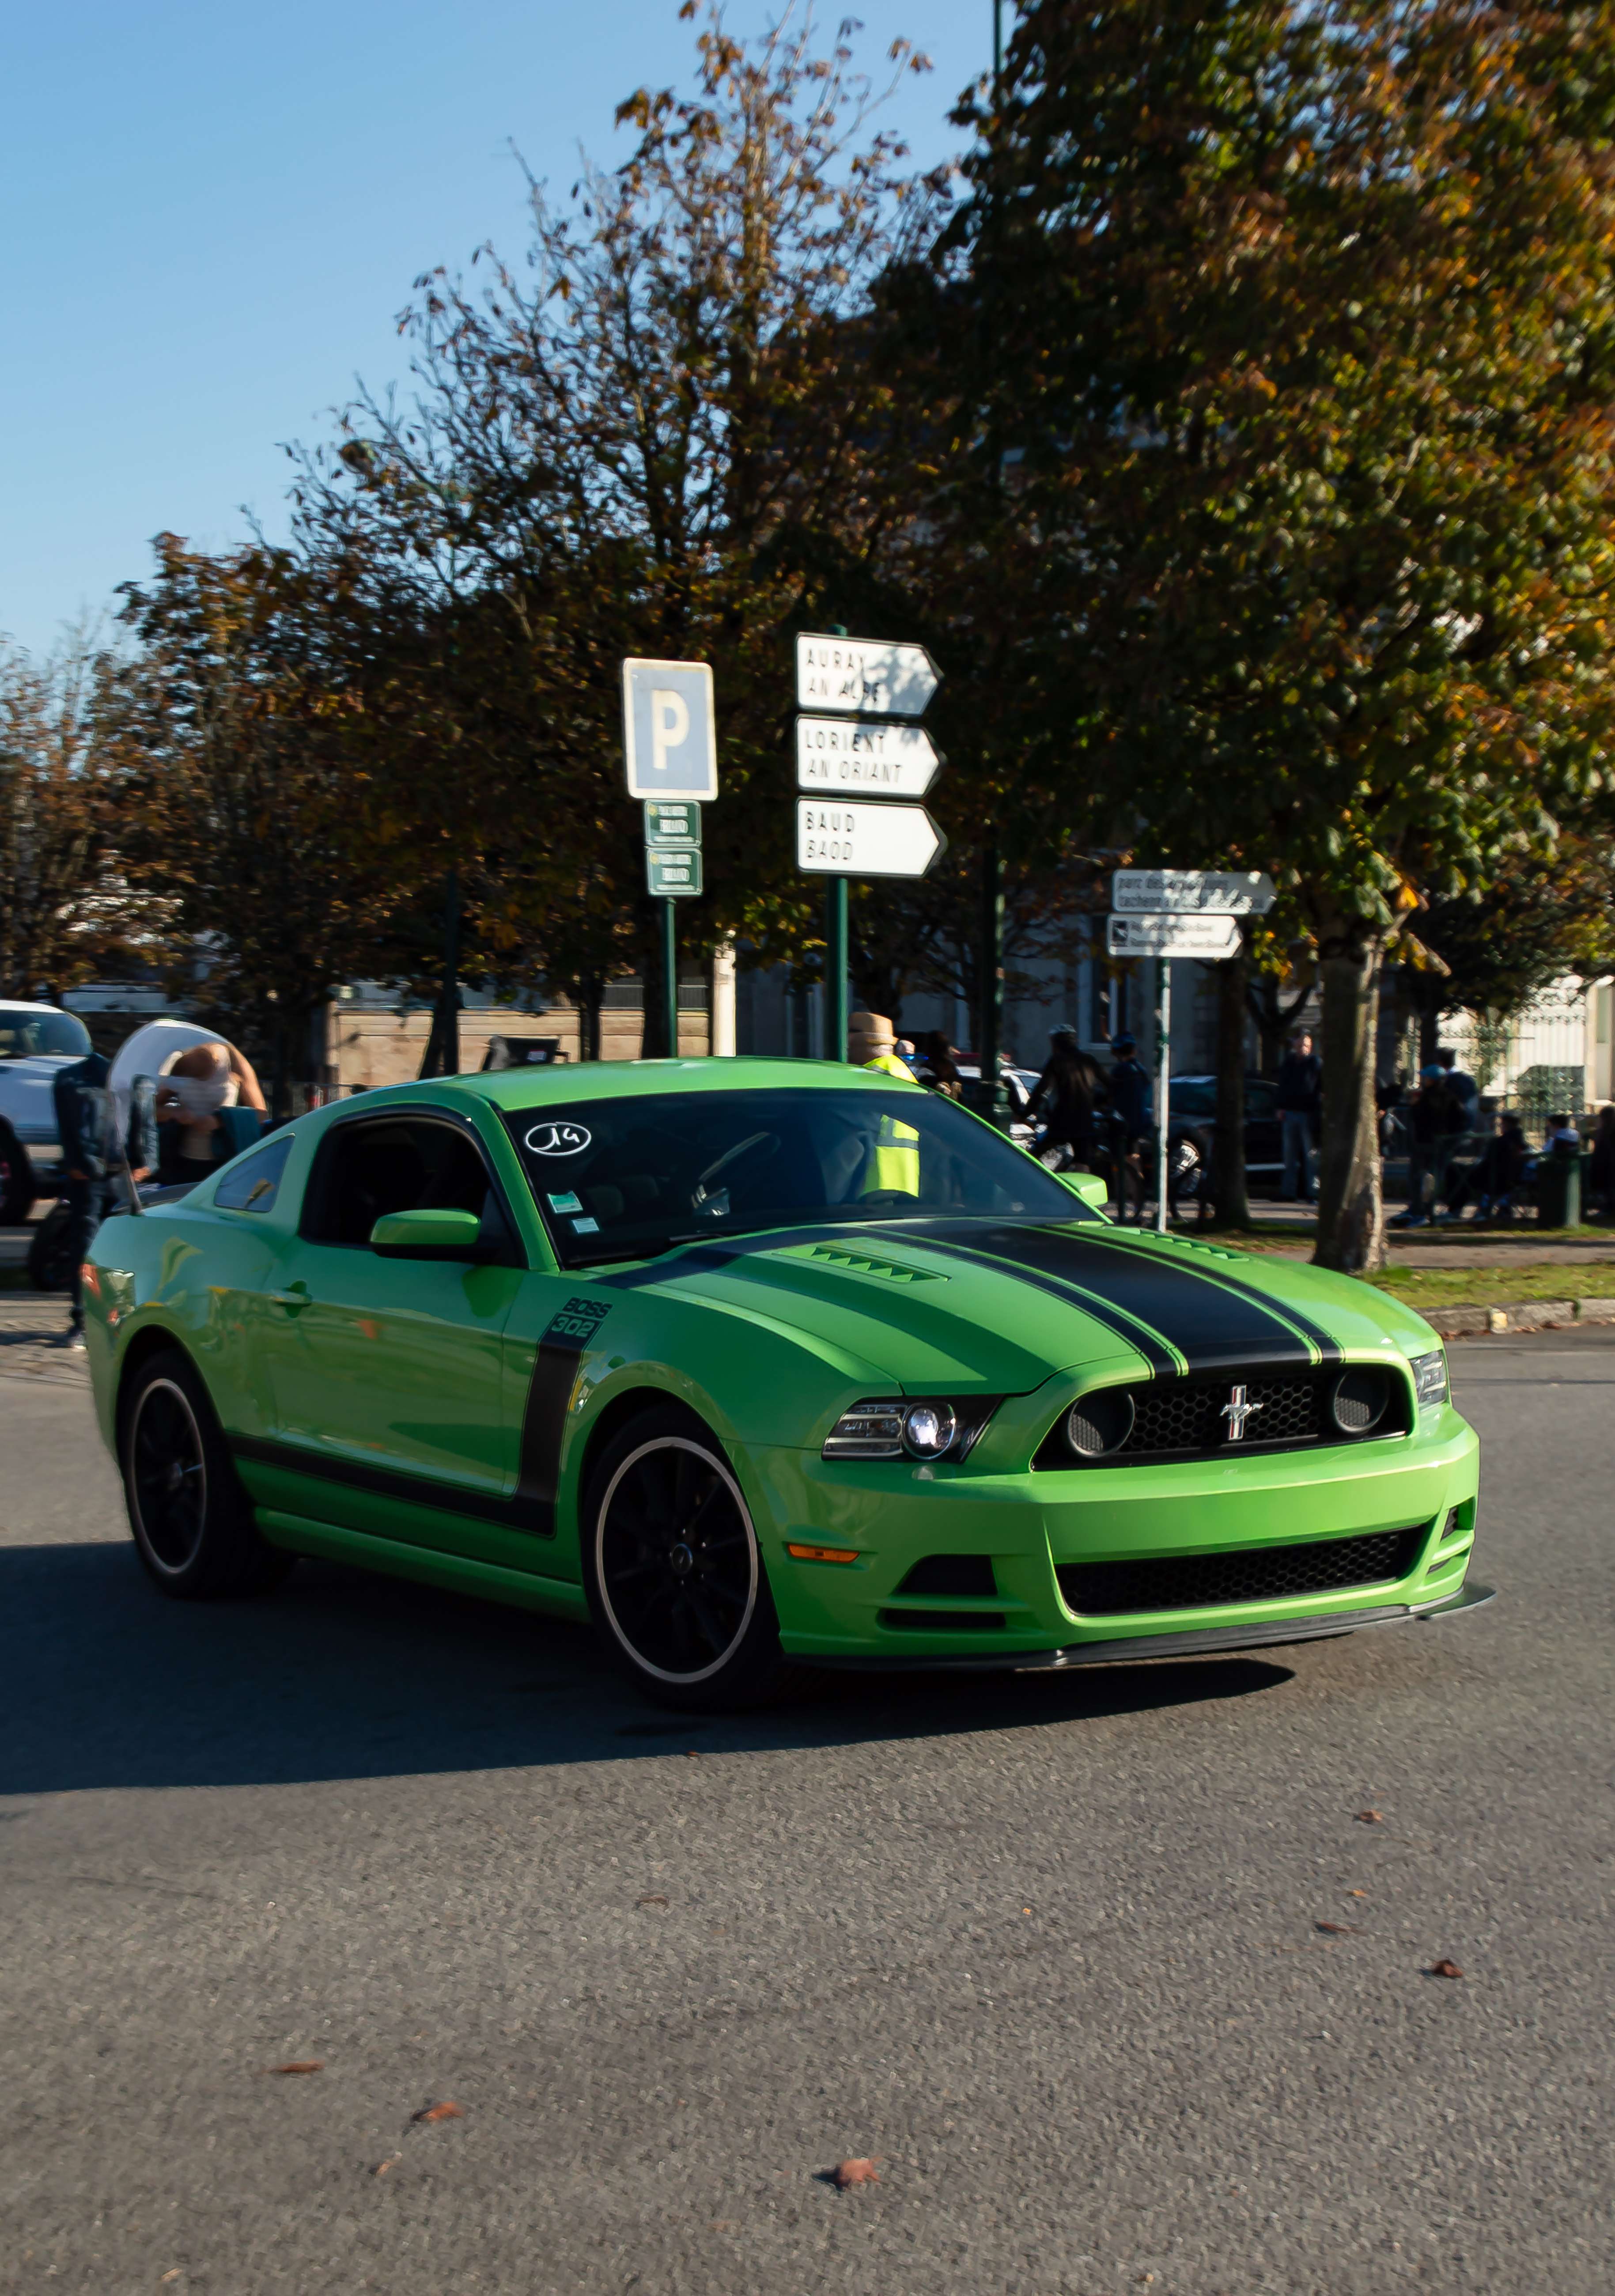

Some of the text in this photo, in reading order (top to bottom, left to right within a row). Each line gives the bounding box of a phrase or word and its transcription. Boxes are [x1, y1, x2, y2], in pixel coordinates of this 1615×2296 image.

[806, 648, 867, 670] AURAY
[806, 677, 828, 696] AN
[651, 689, 689, 769] P
[805, 729, 885, 754] LORIENT
[806, 758, 903, 783] AN ORIANT
[805, 811, 855, 833] BAUD
[806, 839, 853, 861] BAOD
[561, 1296, 613, 1319] BOSS
[551, 1316, 595, 1338] 302
